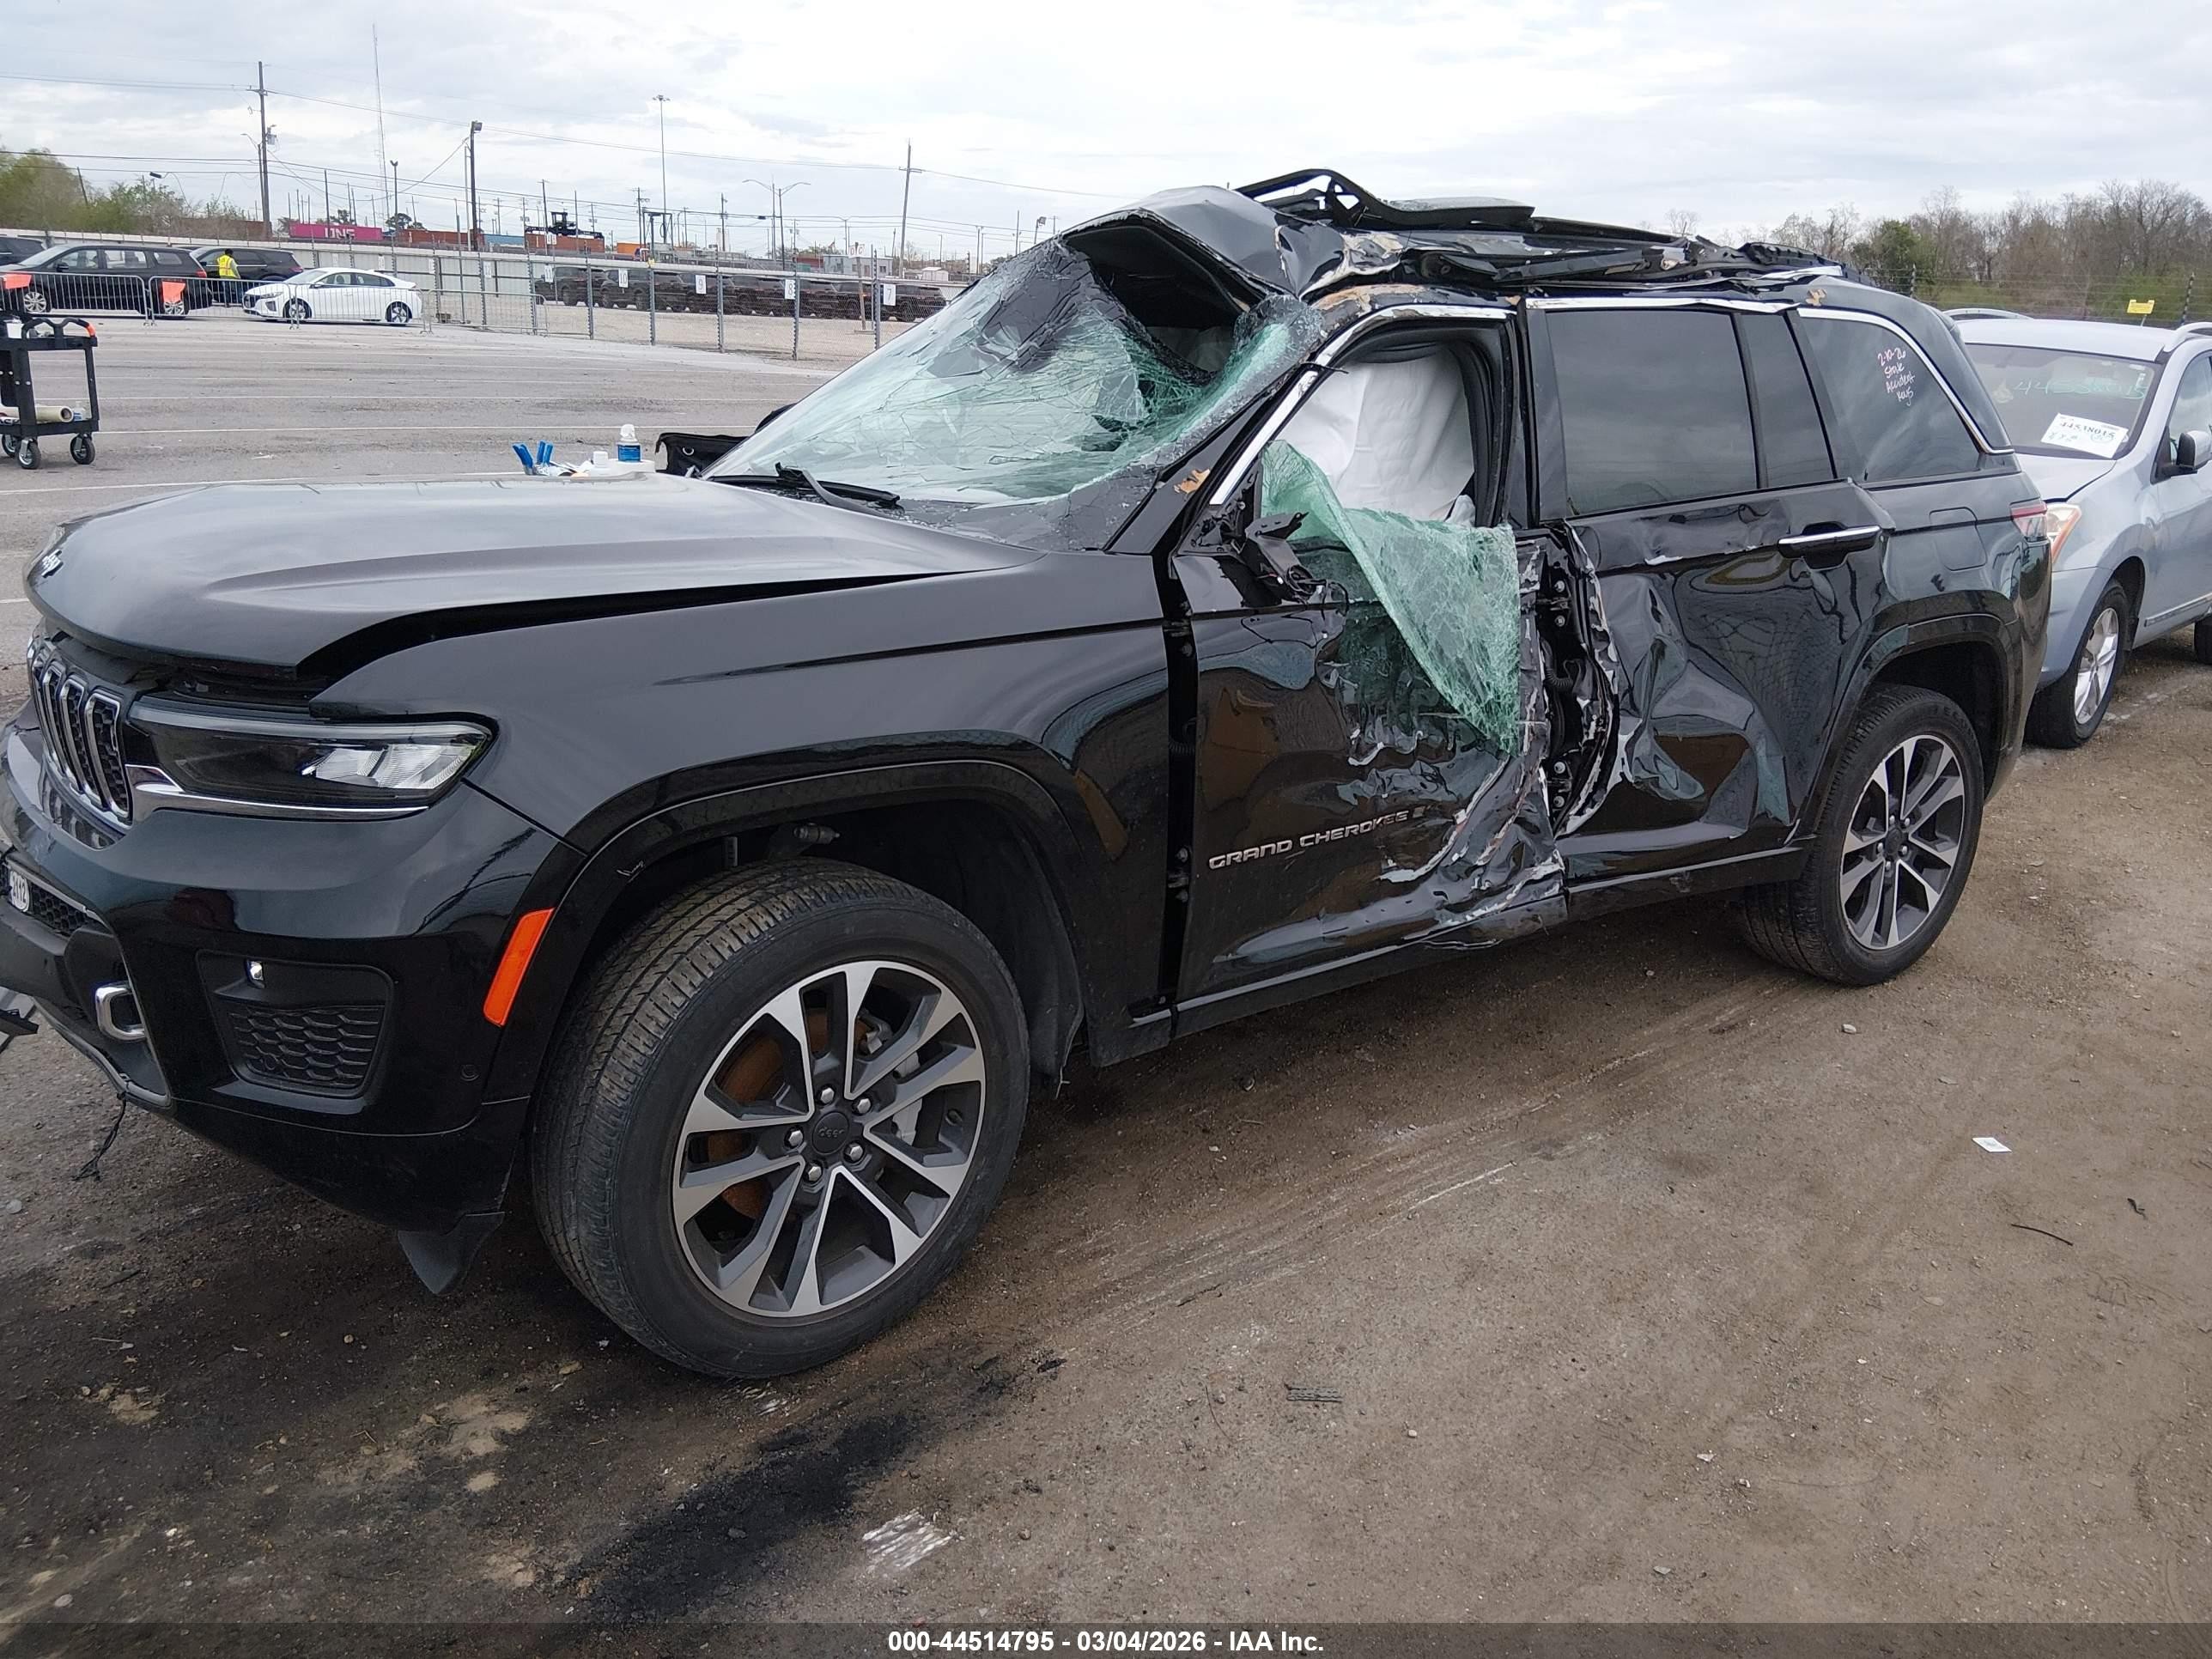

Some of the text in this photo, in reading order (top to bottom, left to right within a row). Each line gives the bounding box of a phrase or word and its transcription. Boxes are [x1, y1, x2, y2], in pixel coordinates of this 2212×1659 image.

[619, 270, 628, 285] 10
[1208, 810, 1410, 871] GRAND CHEROKEE
